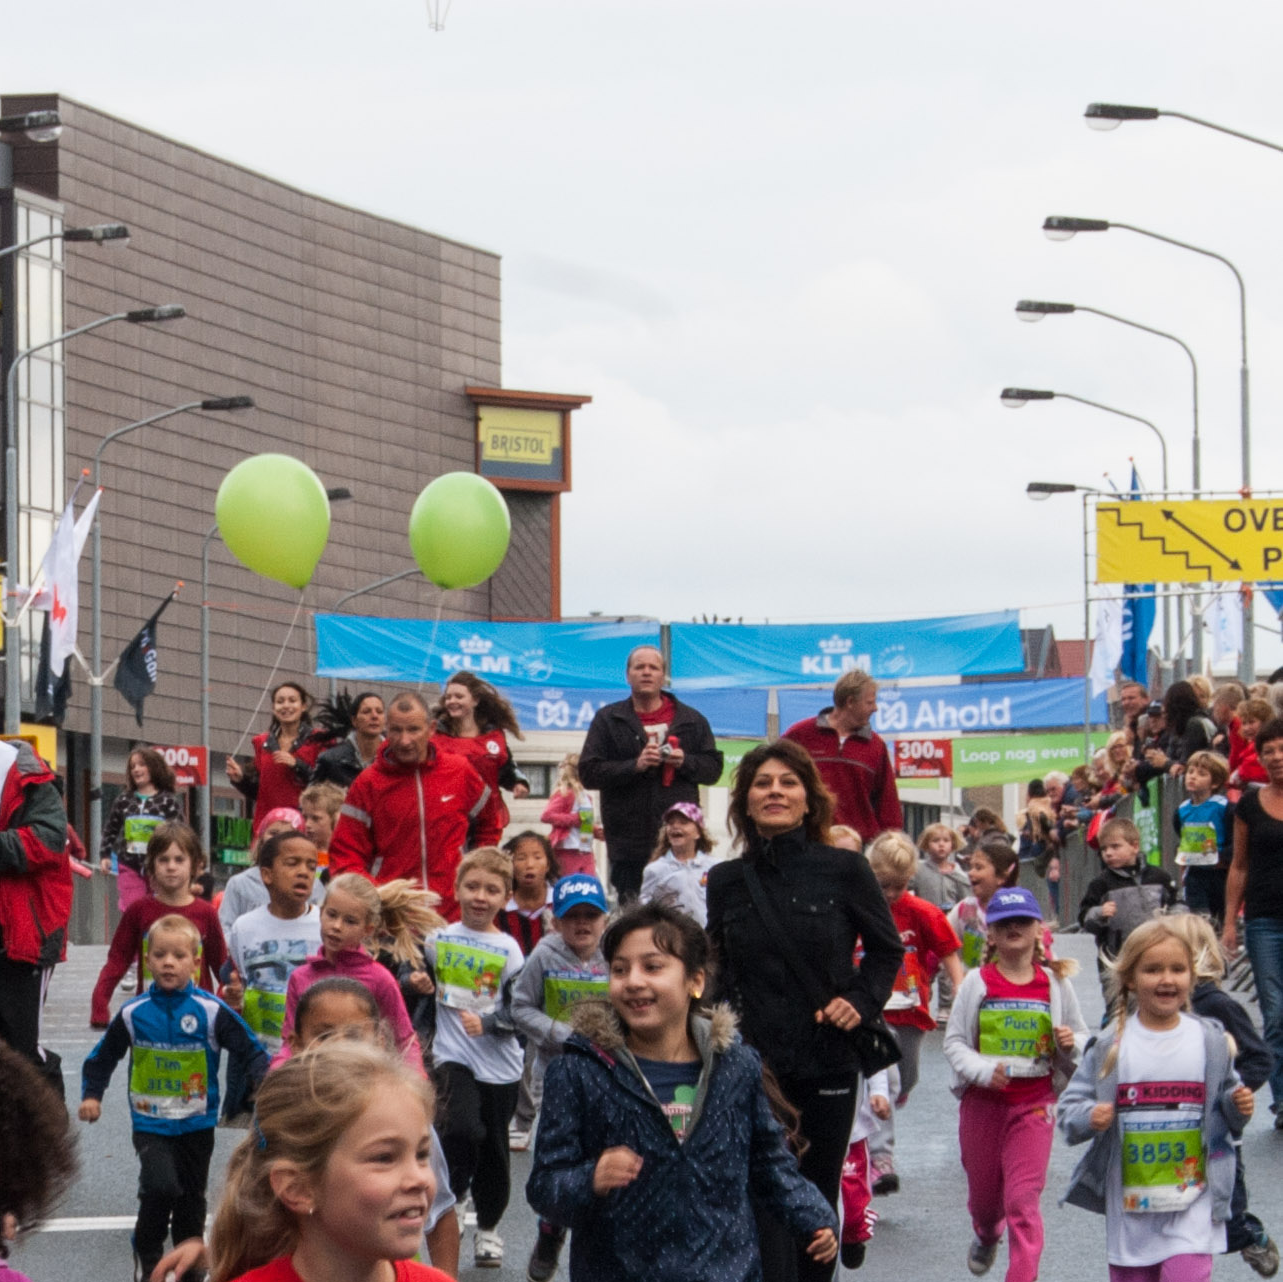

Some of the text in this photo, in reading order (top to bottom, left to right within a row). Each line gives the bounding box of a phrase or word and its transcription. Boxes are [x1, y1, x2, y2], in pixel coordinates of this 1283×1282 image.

[491, 434, 546, 455] BRISTOL
[441, 654, 511, 673] KLM
[802, 654, 871, 675] KLM
[914, 696, 1011, 729] Ahold
[960, 749, 1001, 765] Loop
[1005, 749, 1037, 764] nog
[1041, 747, 1079, 760] even
[1004, 1015, 1038, 1031] Puck
[1143, 1086, 1204, 1099] KIDDING
[1127, 1142, 1187, 1164] 3853
